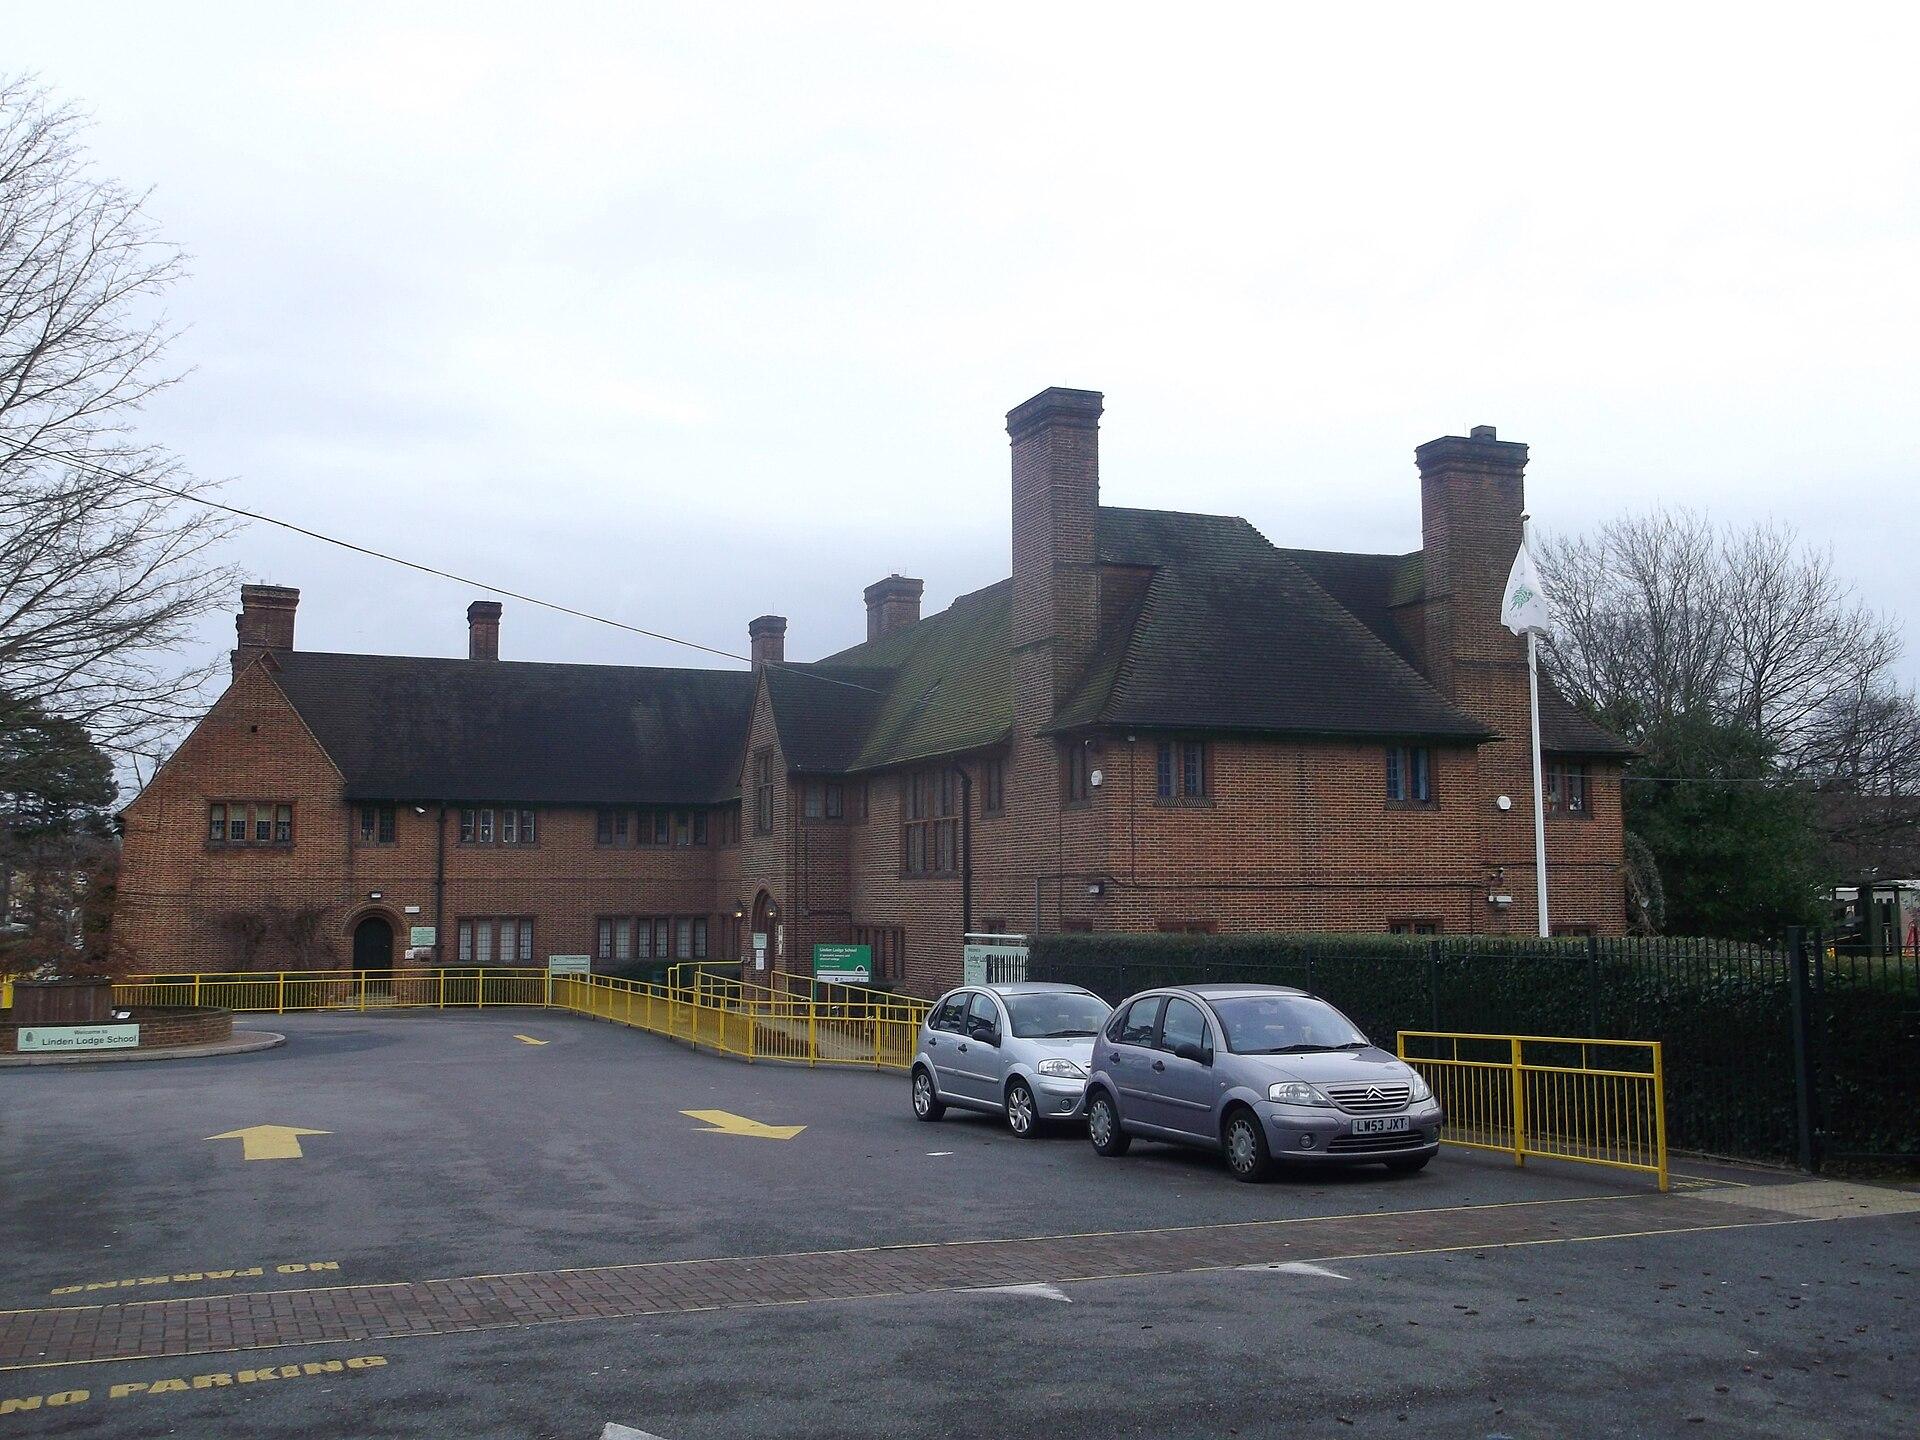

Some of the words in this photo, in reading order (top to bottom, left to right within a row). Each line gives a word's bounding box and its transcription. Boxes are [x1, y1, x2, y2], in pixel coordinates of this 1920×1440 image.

[42, 1038, 74, 1046] Linden
[76, 1037, 104, 1046] Lodge
[107, 1035, 137, 1043] School
[1387, 1117, 1405, 1130] JXT
[276, 1261, 340, 1274] NO
[50, 1267, 264, 1295] PARKING
[0, 1390, 90, 1415] NO
[109, 1355, 388, 1399] PARKING
